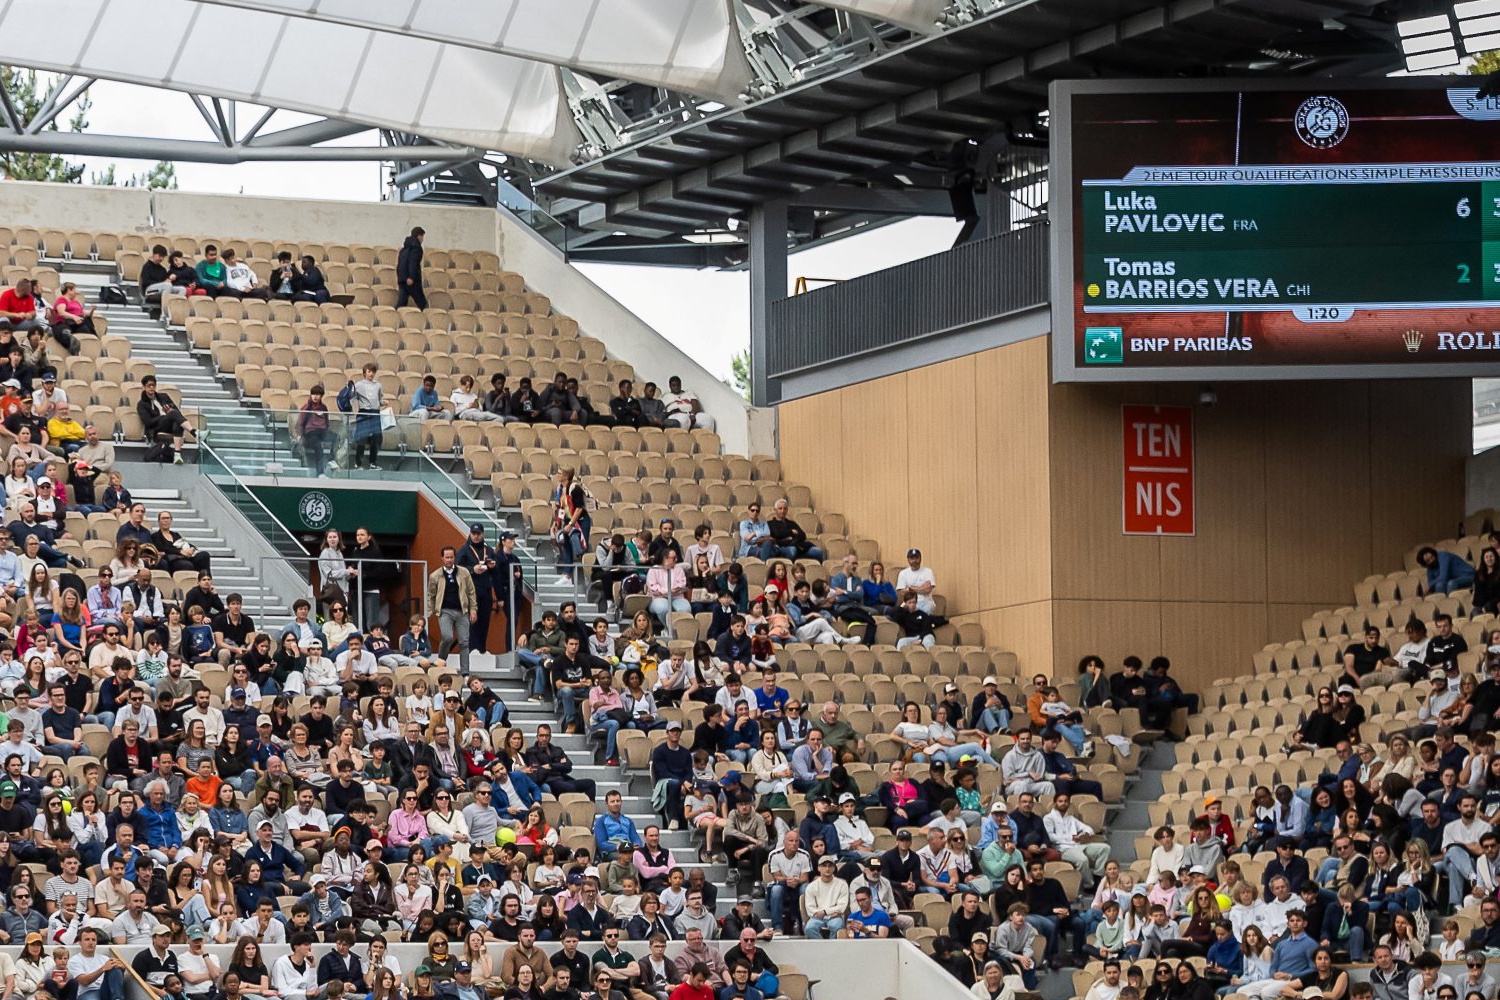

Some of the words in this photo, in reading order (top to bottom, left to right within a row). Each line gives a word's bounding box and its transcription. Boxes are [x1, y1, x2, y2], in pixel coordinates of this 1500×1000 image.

[1144, 169, 1184, 181] 2ÈME
[1190, 171, 1227, 181] TOUR
[1232, 168, 1357, 181] QUALIFICATIONS
[1363, 168, 1414, 179] SIMPLE
[1420, 166, 1500, 178] MESSIEURS
[1105, 191, 1157, 211] Luka
[1456, 198, 1471, 218] 6
[1105, 214, 1225, 233] PAVLOVIC
[1234, 220, 1259, 232] FRA
[1104, 258, 1176, 276] Tomas
[1457, 264, 1471, 283] 2
[1106, 279, 1209, 299] BARRIOS
[1214, 278, 1280, 298] VERA
[1286, 284, 1311, 296] CHI
[1308, 308, 1339, 320] 1:20
[1131, 338, 1169, 352] BNP
[1174, 337, 1253, 352] PARIBAS
[1132, 423, 1181, 458] TEN
[1136, 481, 1182, 517] NIS
